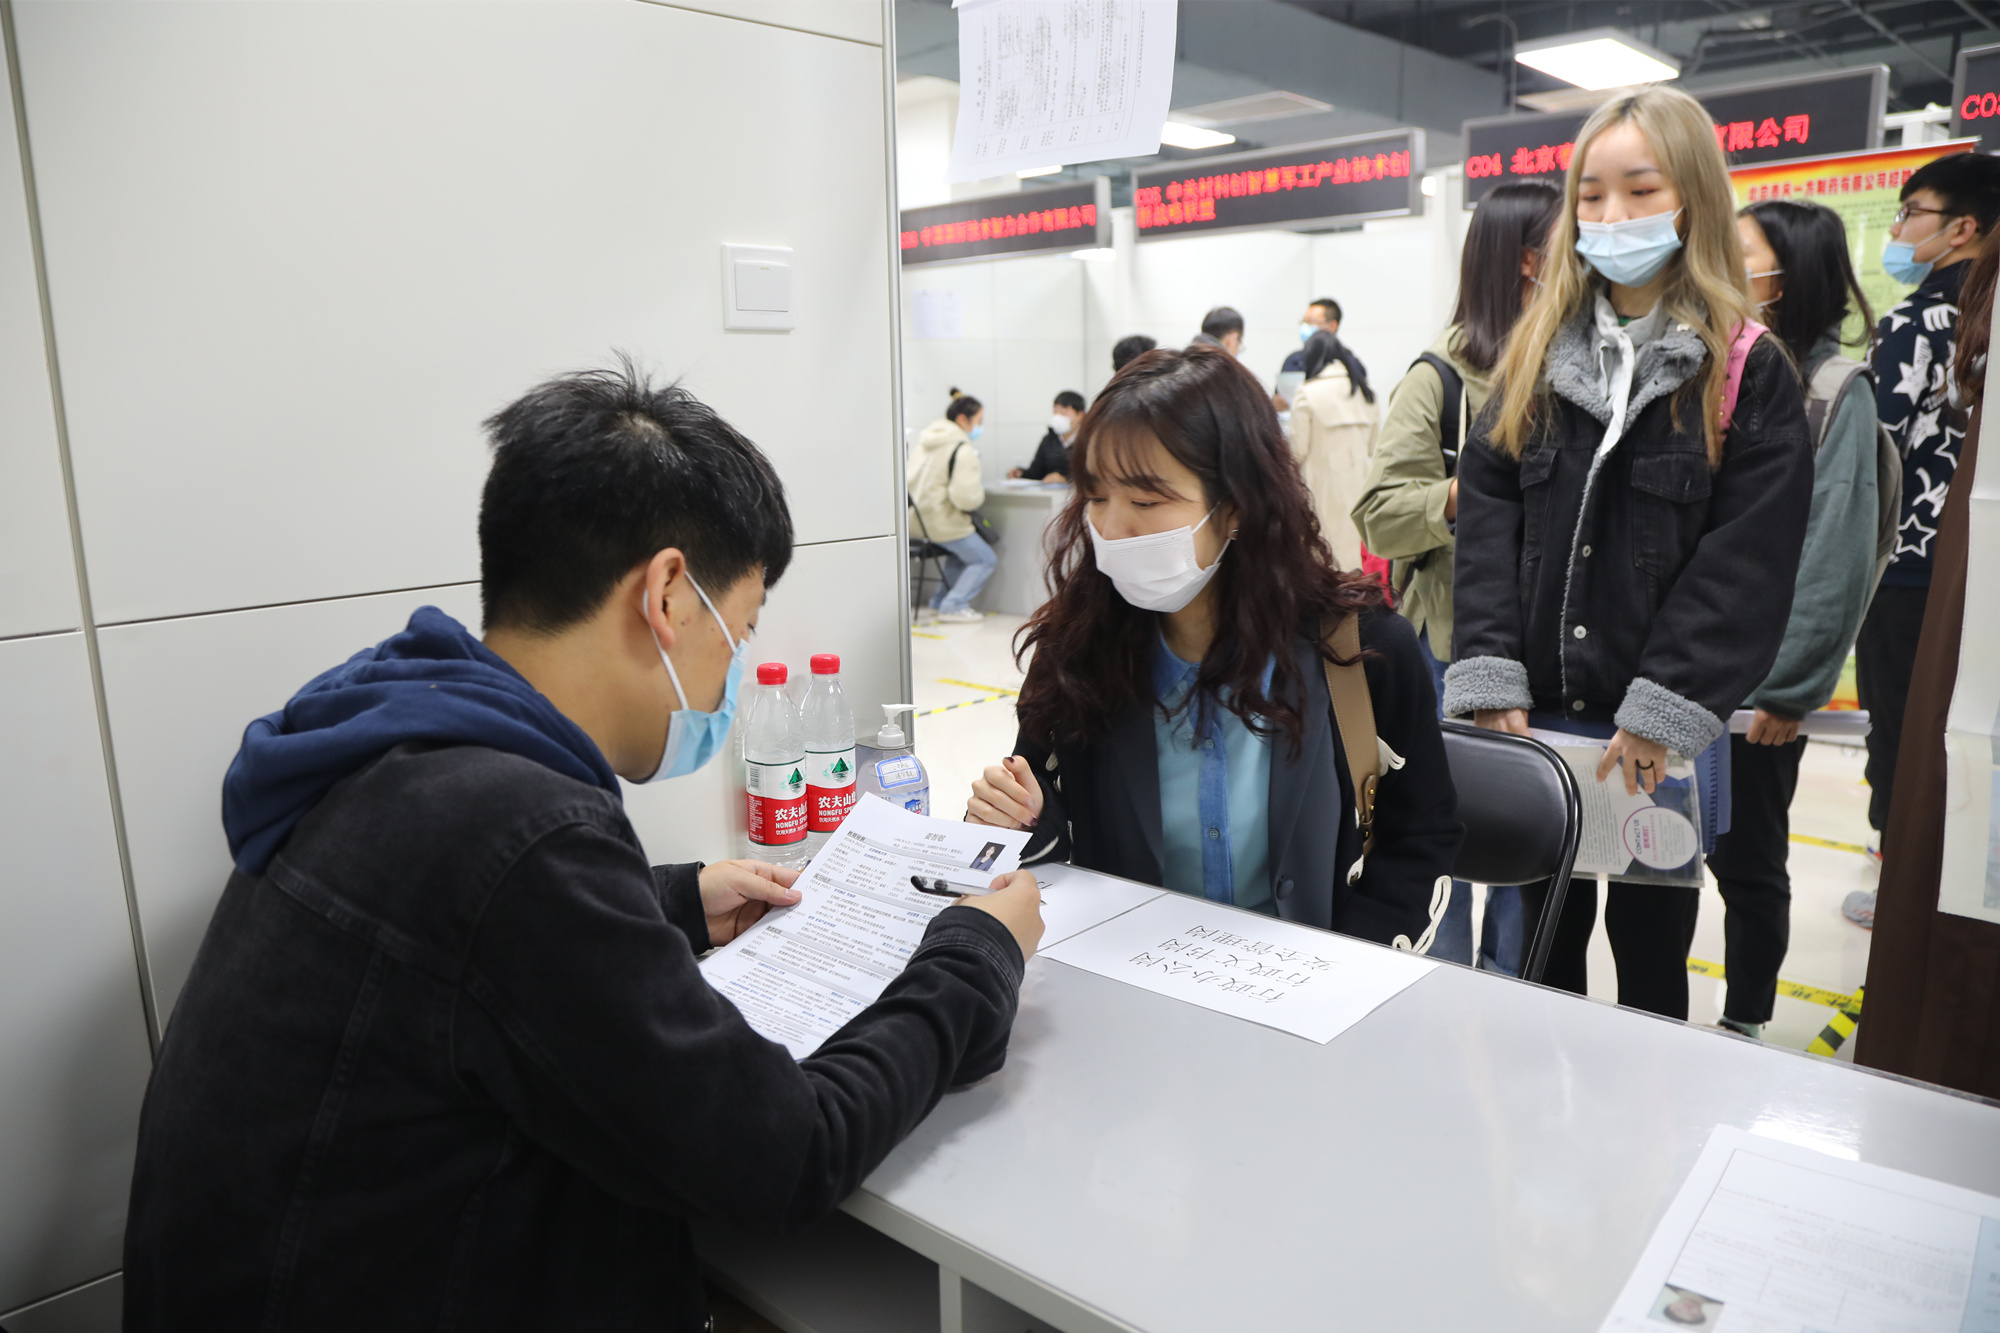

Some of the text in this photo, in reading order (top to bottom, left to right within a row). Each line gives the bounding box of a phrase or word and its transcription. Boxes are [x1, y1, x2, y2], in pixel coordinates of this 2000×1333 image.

[1960, 92, 2000, 120] C0
[775, 820, 799, 829] NONGFU
[818, 808, 843, 817] NONGFU
[1157, 938, 1311, 987] 行政文书岗
[1185, 925, 1341, 971] 安全管理岗
[1129, 951, 1285, 1003] 行政办公岗
